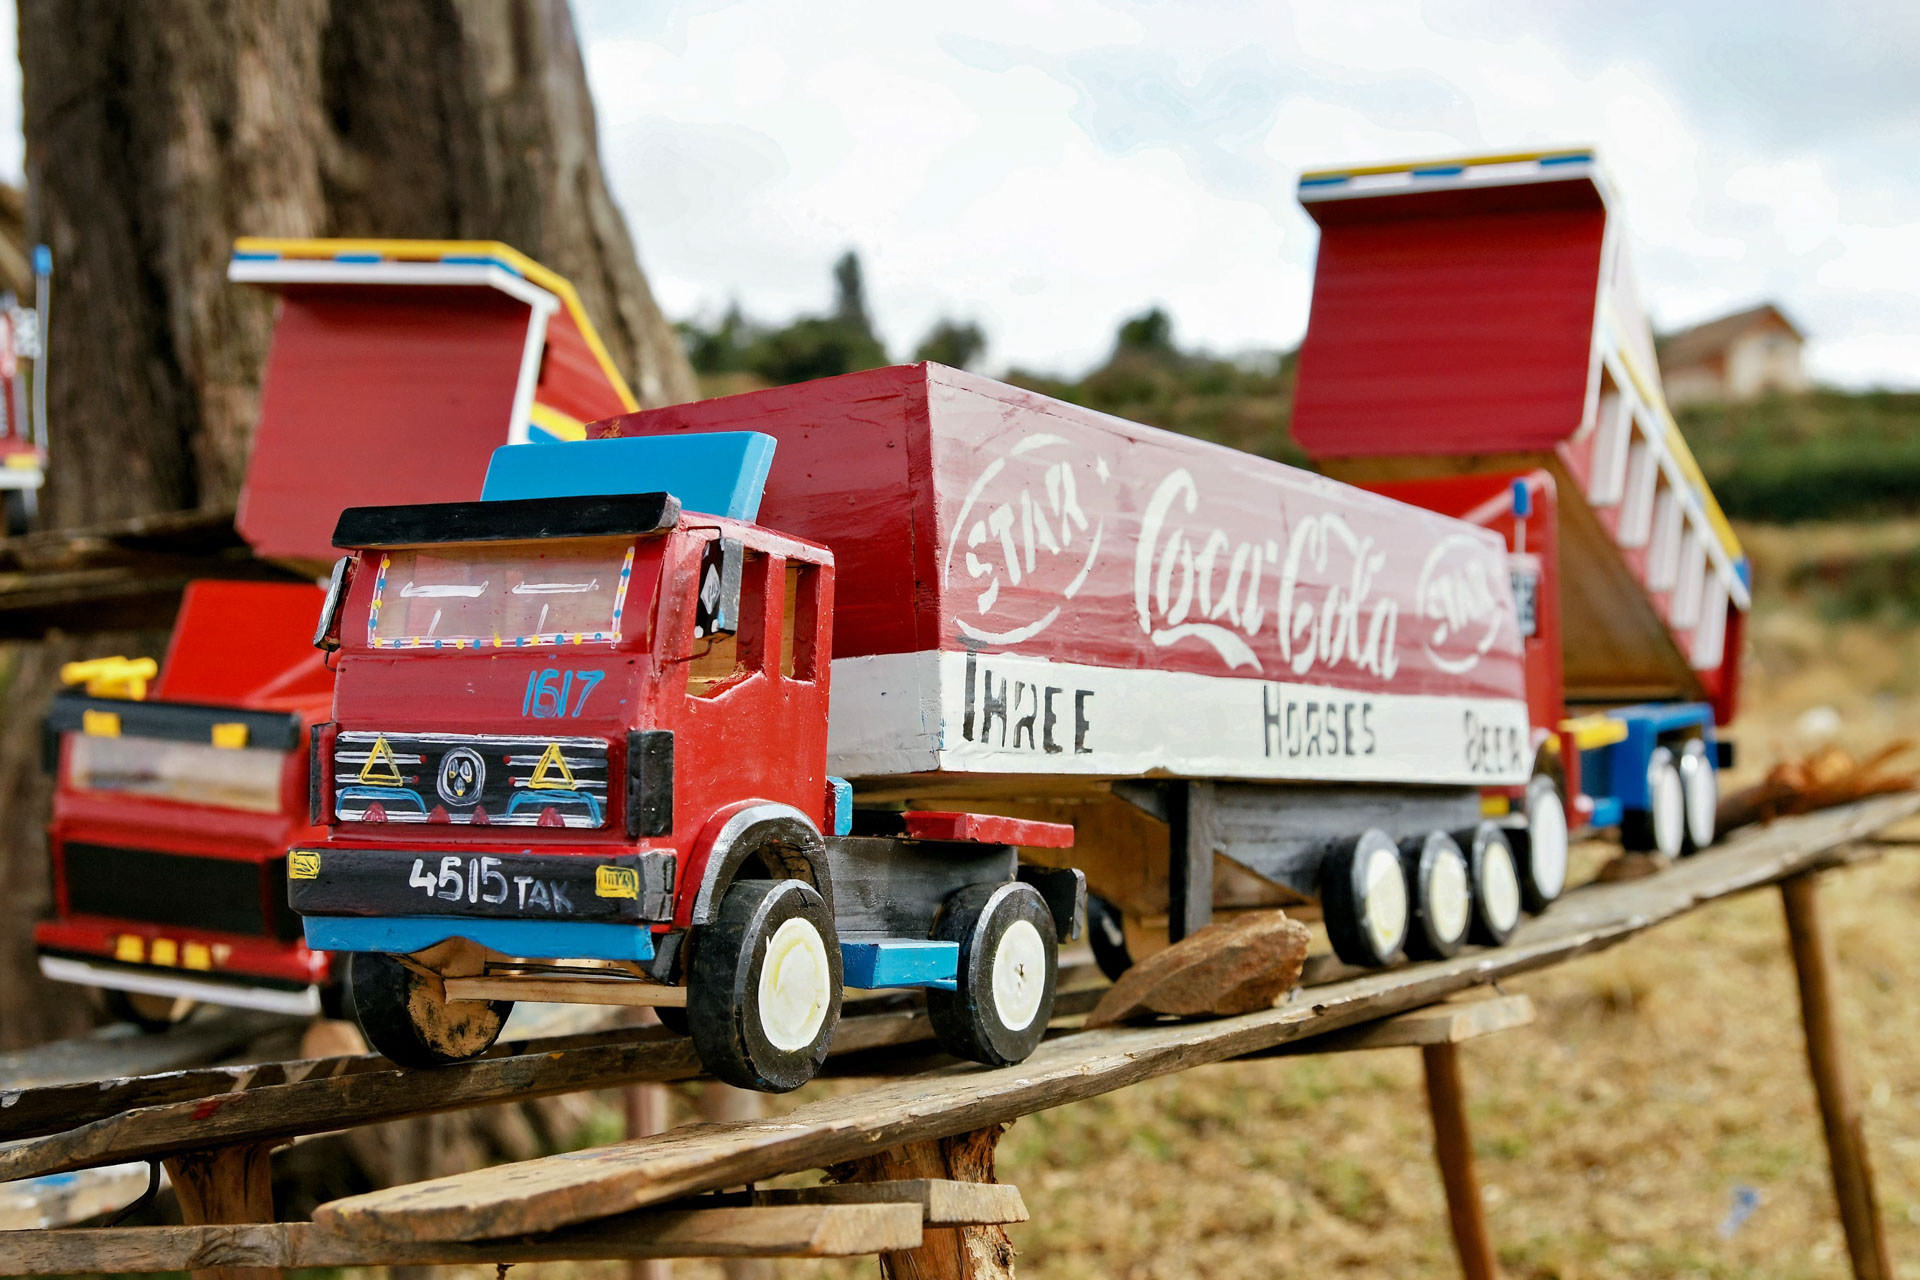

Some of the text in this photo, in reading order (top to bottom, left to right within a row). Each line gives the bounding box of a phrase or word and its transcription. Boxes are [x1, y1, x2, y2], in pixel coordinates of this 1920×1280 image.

[966, 461, 1089, 615] STAR
[523, 669, 605, 717] 1617
[957, 634, 1096, 756] THREE
[1262, 682, 1376, 758] HORSES
[408, 856, 508, 904] 4515
